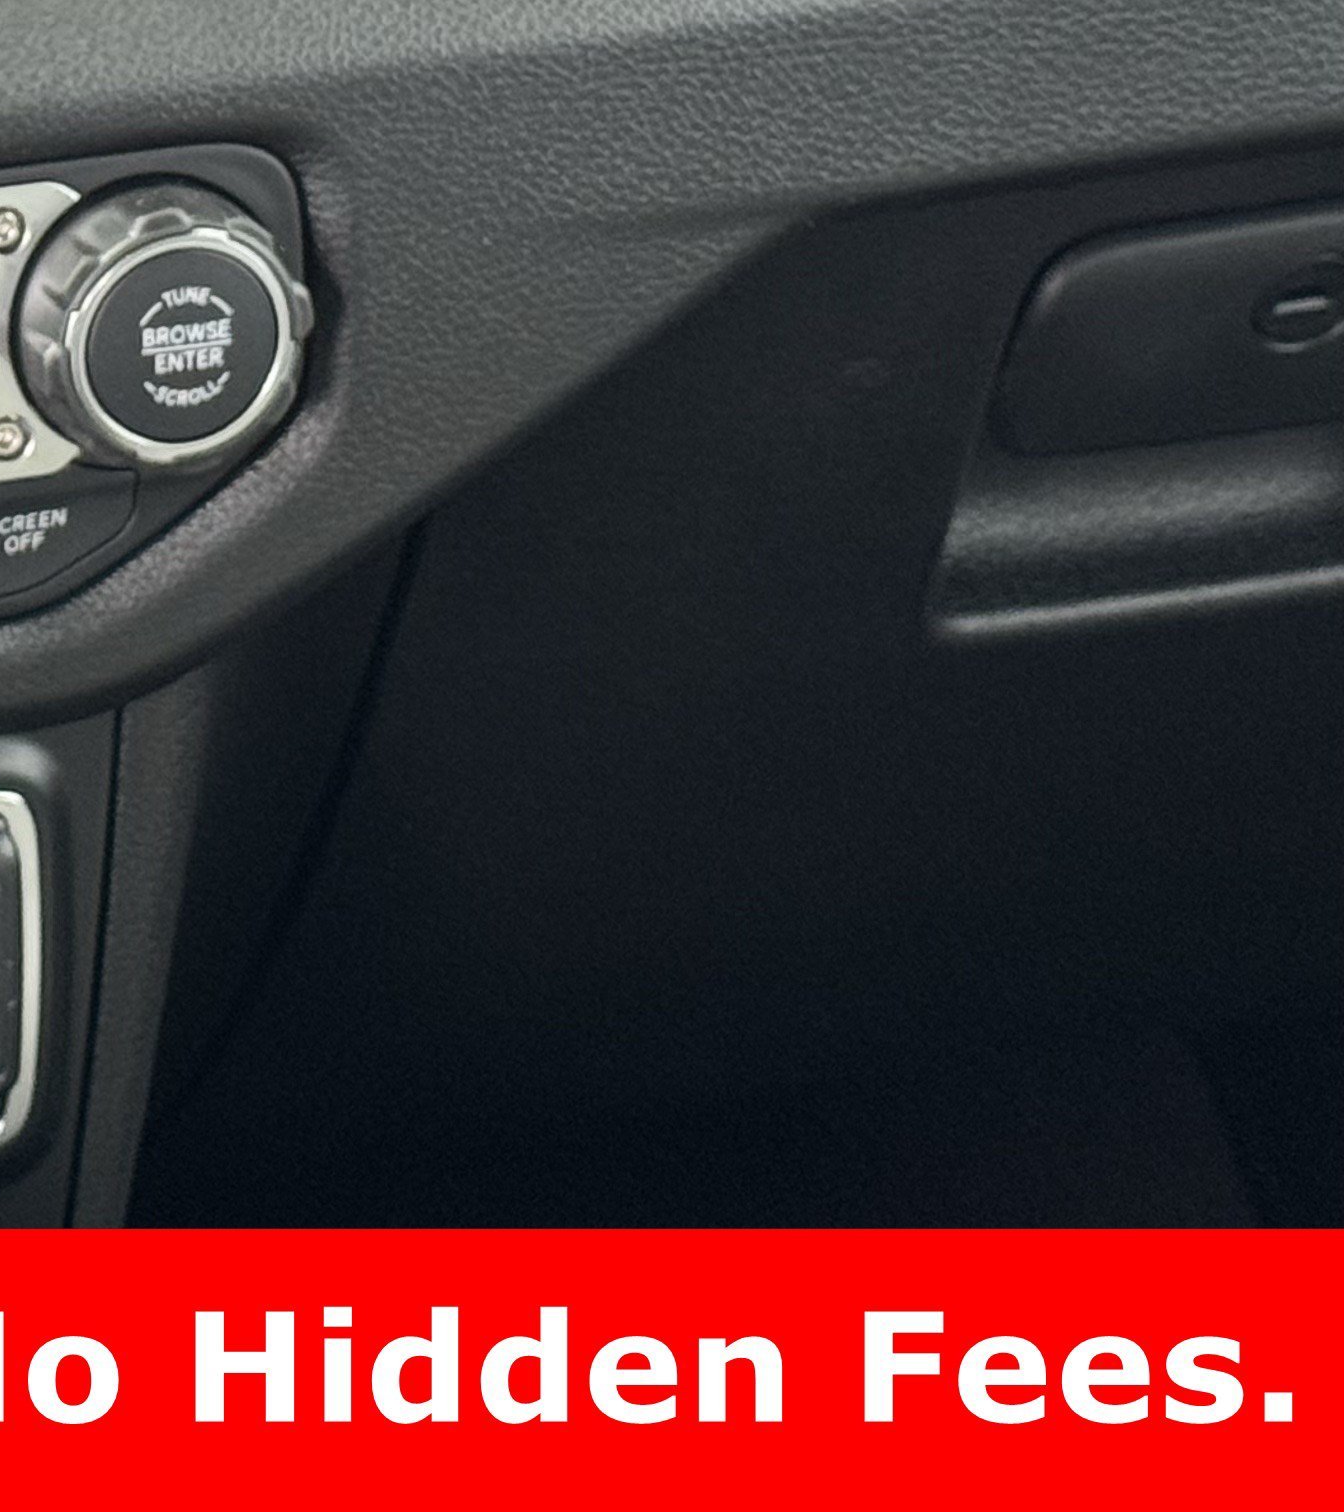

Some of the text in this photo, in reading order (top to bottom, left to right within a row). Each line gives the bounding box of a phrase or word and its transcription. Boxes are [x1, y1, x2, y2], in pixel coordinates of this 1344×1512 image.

[160, 285, 212, 308] TUNE
[141, 316, 233, 348] BROWSE
[153, 346, 226, 376] ENTER
[151, 380, 218, 408] SCROLL
[3, 531, 46, 556] OFF
